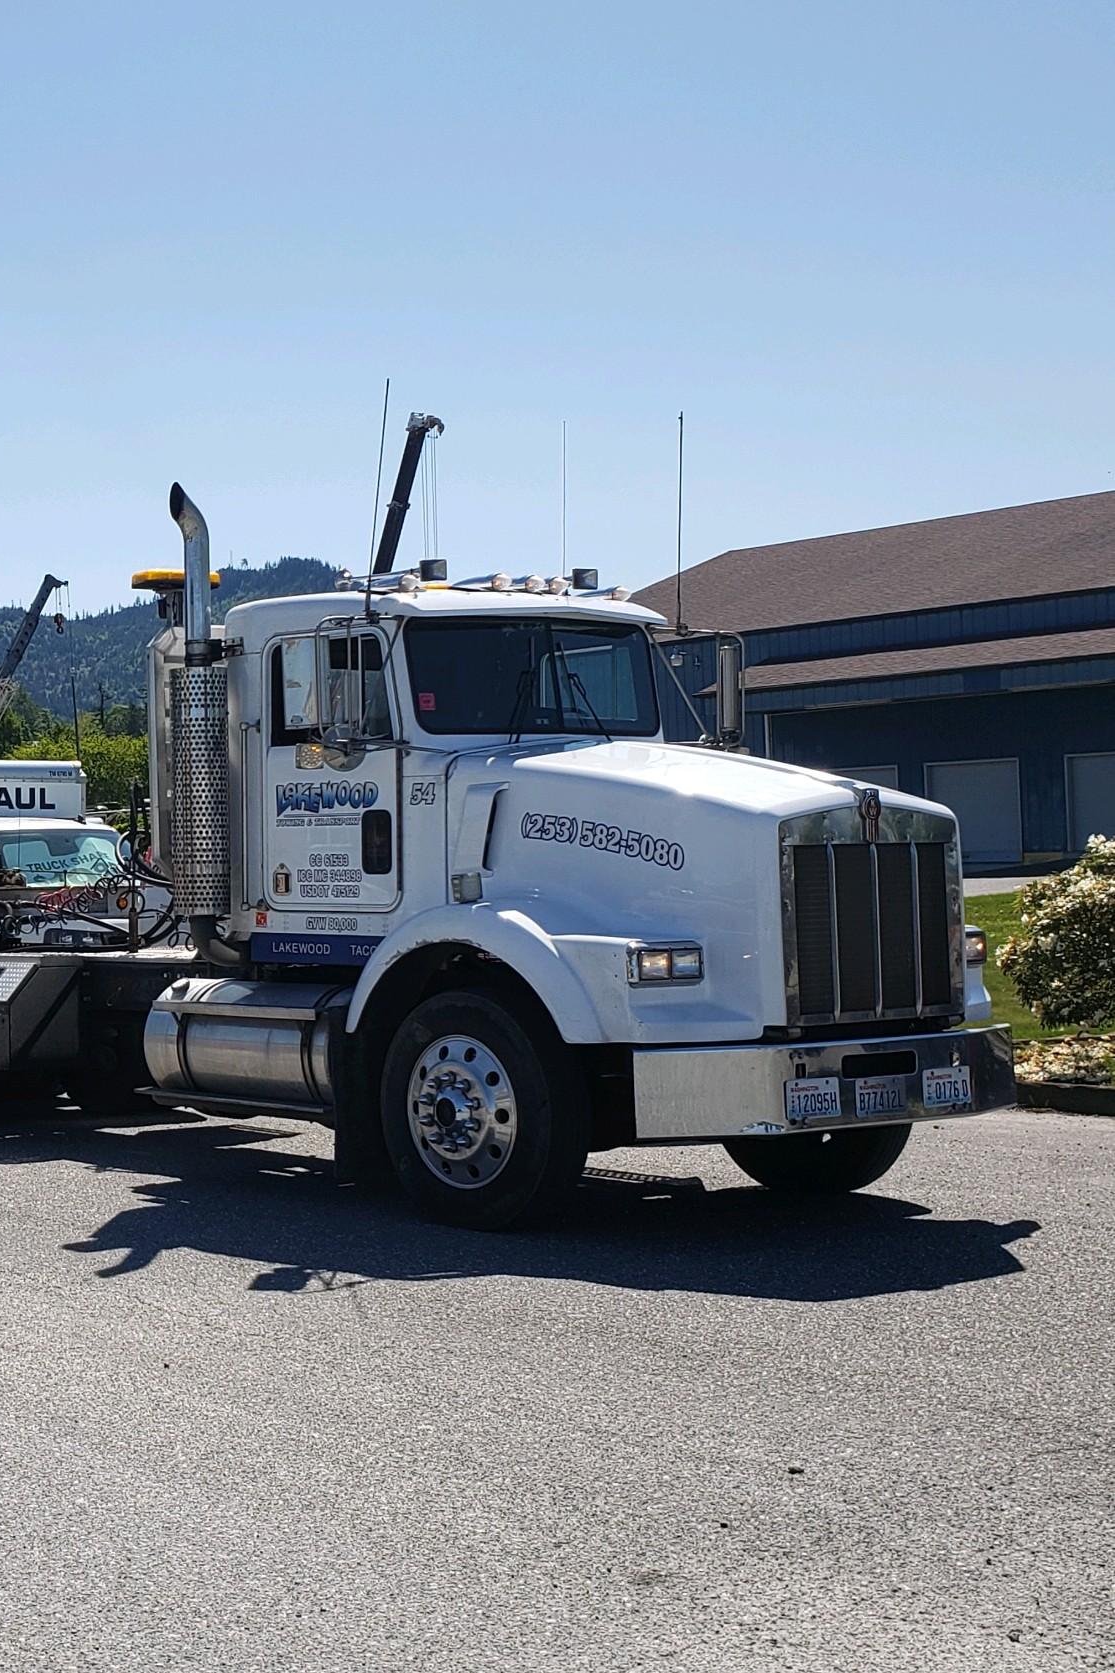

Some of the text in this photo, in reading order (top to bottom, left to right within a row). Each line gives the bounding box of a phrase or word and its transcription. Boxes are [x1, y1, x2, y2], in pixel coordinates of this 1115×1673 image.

[276, 780, 379, 817] LAKEWOOD
[410, 783, 436, 805] 54
[521, 812, 684, 870] (253) 582-5080
[26, 859, 68, 872] TRUCK
[309, 854, 322, 867] CC
[297, 869, 313, 882] ICC
[314, 869, 328, 882] MC
[300, 885, 330, 897] USDOT
[306, 917, 327, 930] GVW
[272, 942, 331, 954] LAKEWOOD
[797, 1091, 838, 1114] 12095H
